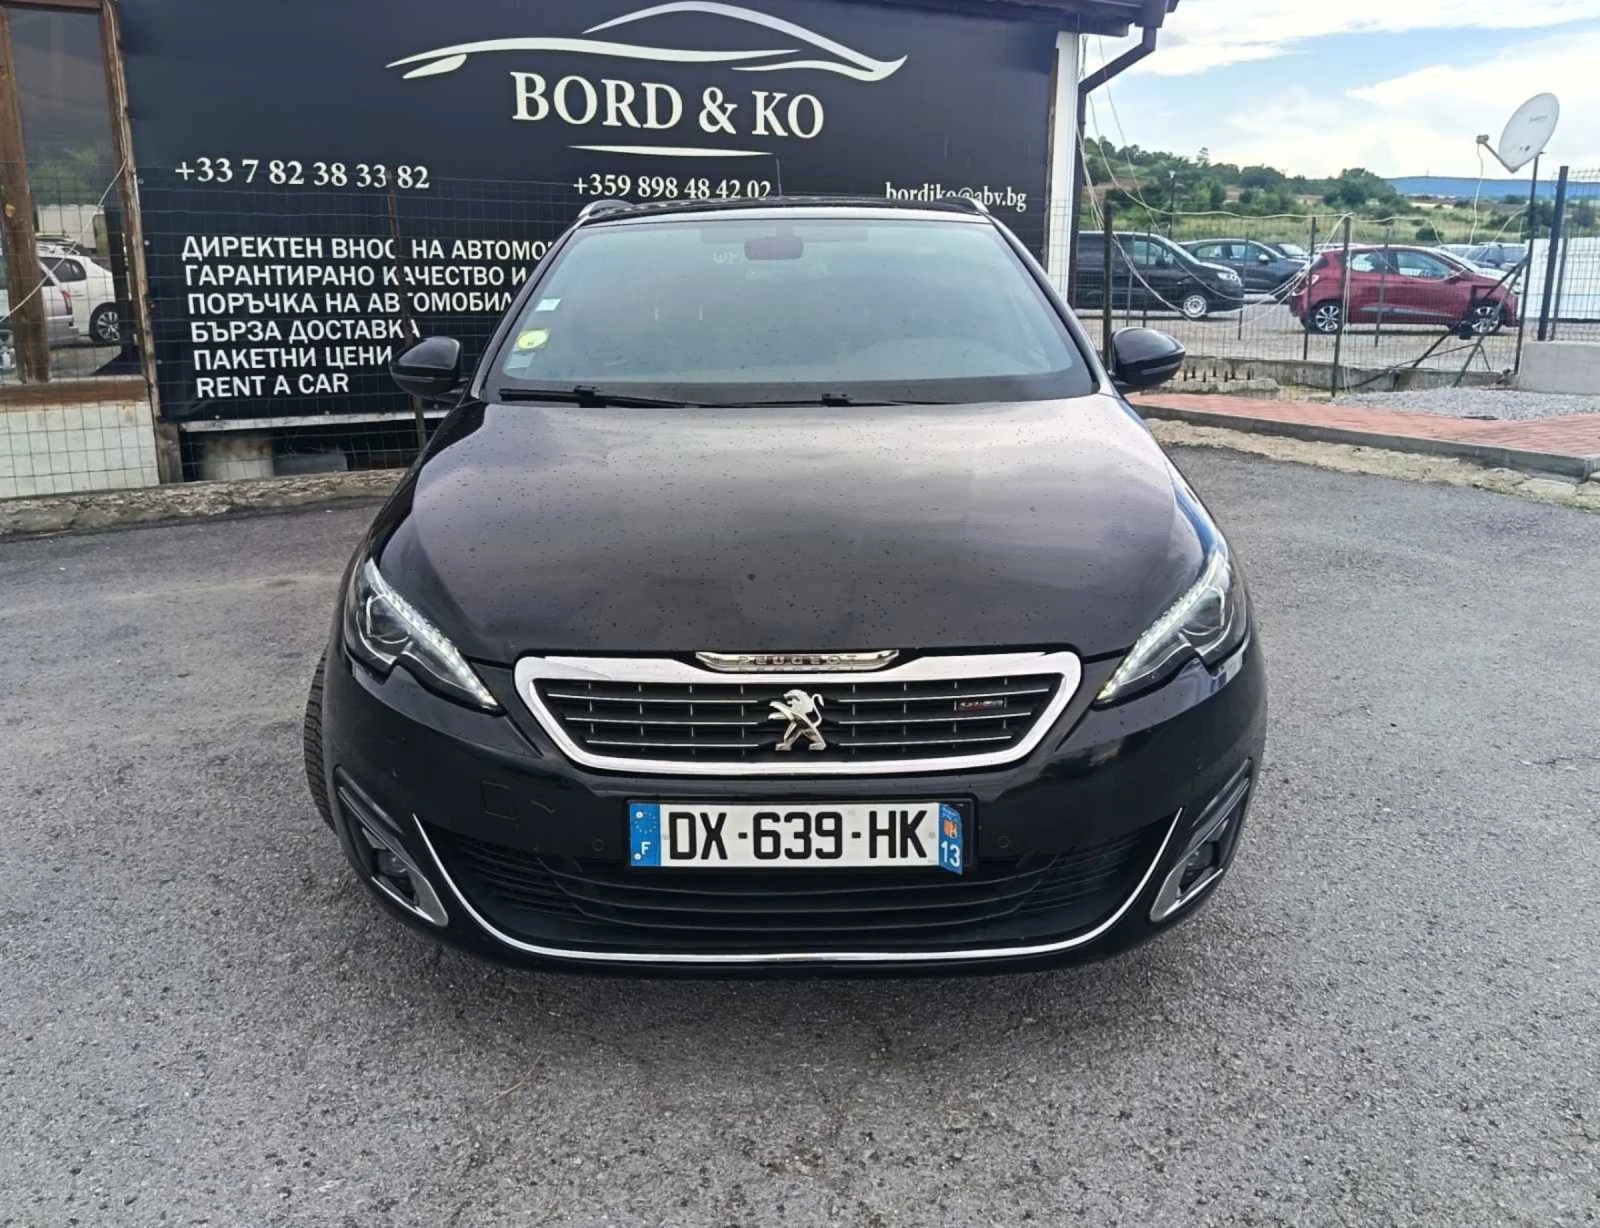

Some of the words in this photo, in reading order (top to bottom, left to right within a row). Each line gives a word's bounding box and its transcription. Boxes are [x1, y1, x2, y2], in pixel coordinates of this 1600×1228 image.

[510, 71, 683, 129] BORD
[699, 86, 738, 134] &
[751, 90, 824, 139] KO
[175, 157, 233, 182] +33
[242, 159, 259, 183] 7
[269, 160, 305, 185] 82
[313, 162, 348, 187] 38
[356, 164, 387, 188] 33
[397, 165, 430, 189] 82
[573, 173, 632, 196] +359
[638, 176, 678, 198] 898
[684, 178, 710, 199] 48
[716, 179, 741, 199] 42
[747, 180, 772, 198] 02
[182, 235, 322, 261] ДИРЕКТЕН
[331, 238, 395, 259] ВНОС
[411, 239, 445, 259] НА
[451, 240, 552, 260] АВТОМО
[185, 265, 375, 286] ГАРАНТИРАНО
[511, 267, 526, 286] И
[187, 292, 318, 315] ПОРЪЧКА
[325, 292, 361, 313] НА
[190, 320, 282, 343] БЪРЗА
[193, 347, 317, 370] ПАКЕТНИ
[325, 345, 392, 369] ЦЕНИ
[196, 375, 266, 398] RENT
[273, 374, 291, 395] A
[298, 372, 349, 394] CAR
[641, 841, 651, 855] F
[668, 810, 928, 860] DX-639-HK
[941, 841, 961, 867] 13
